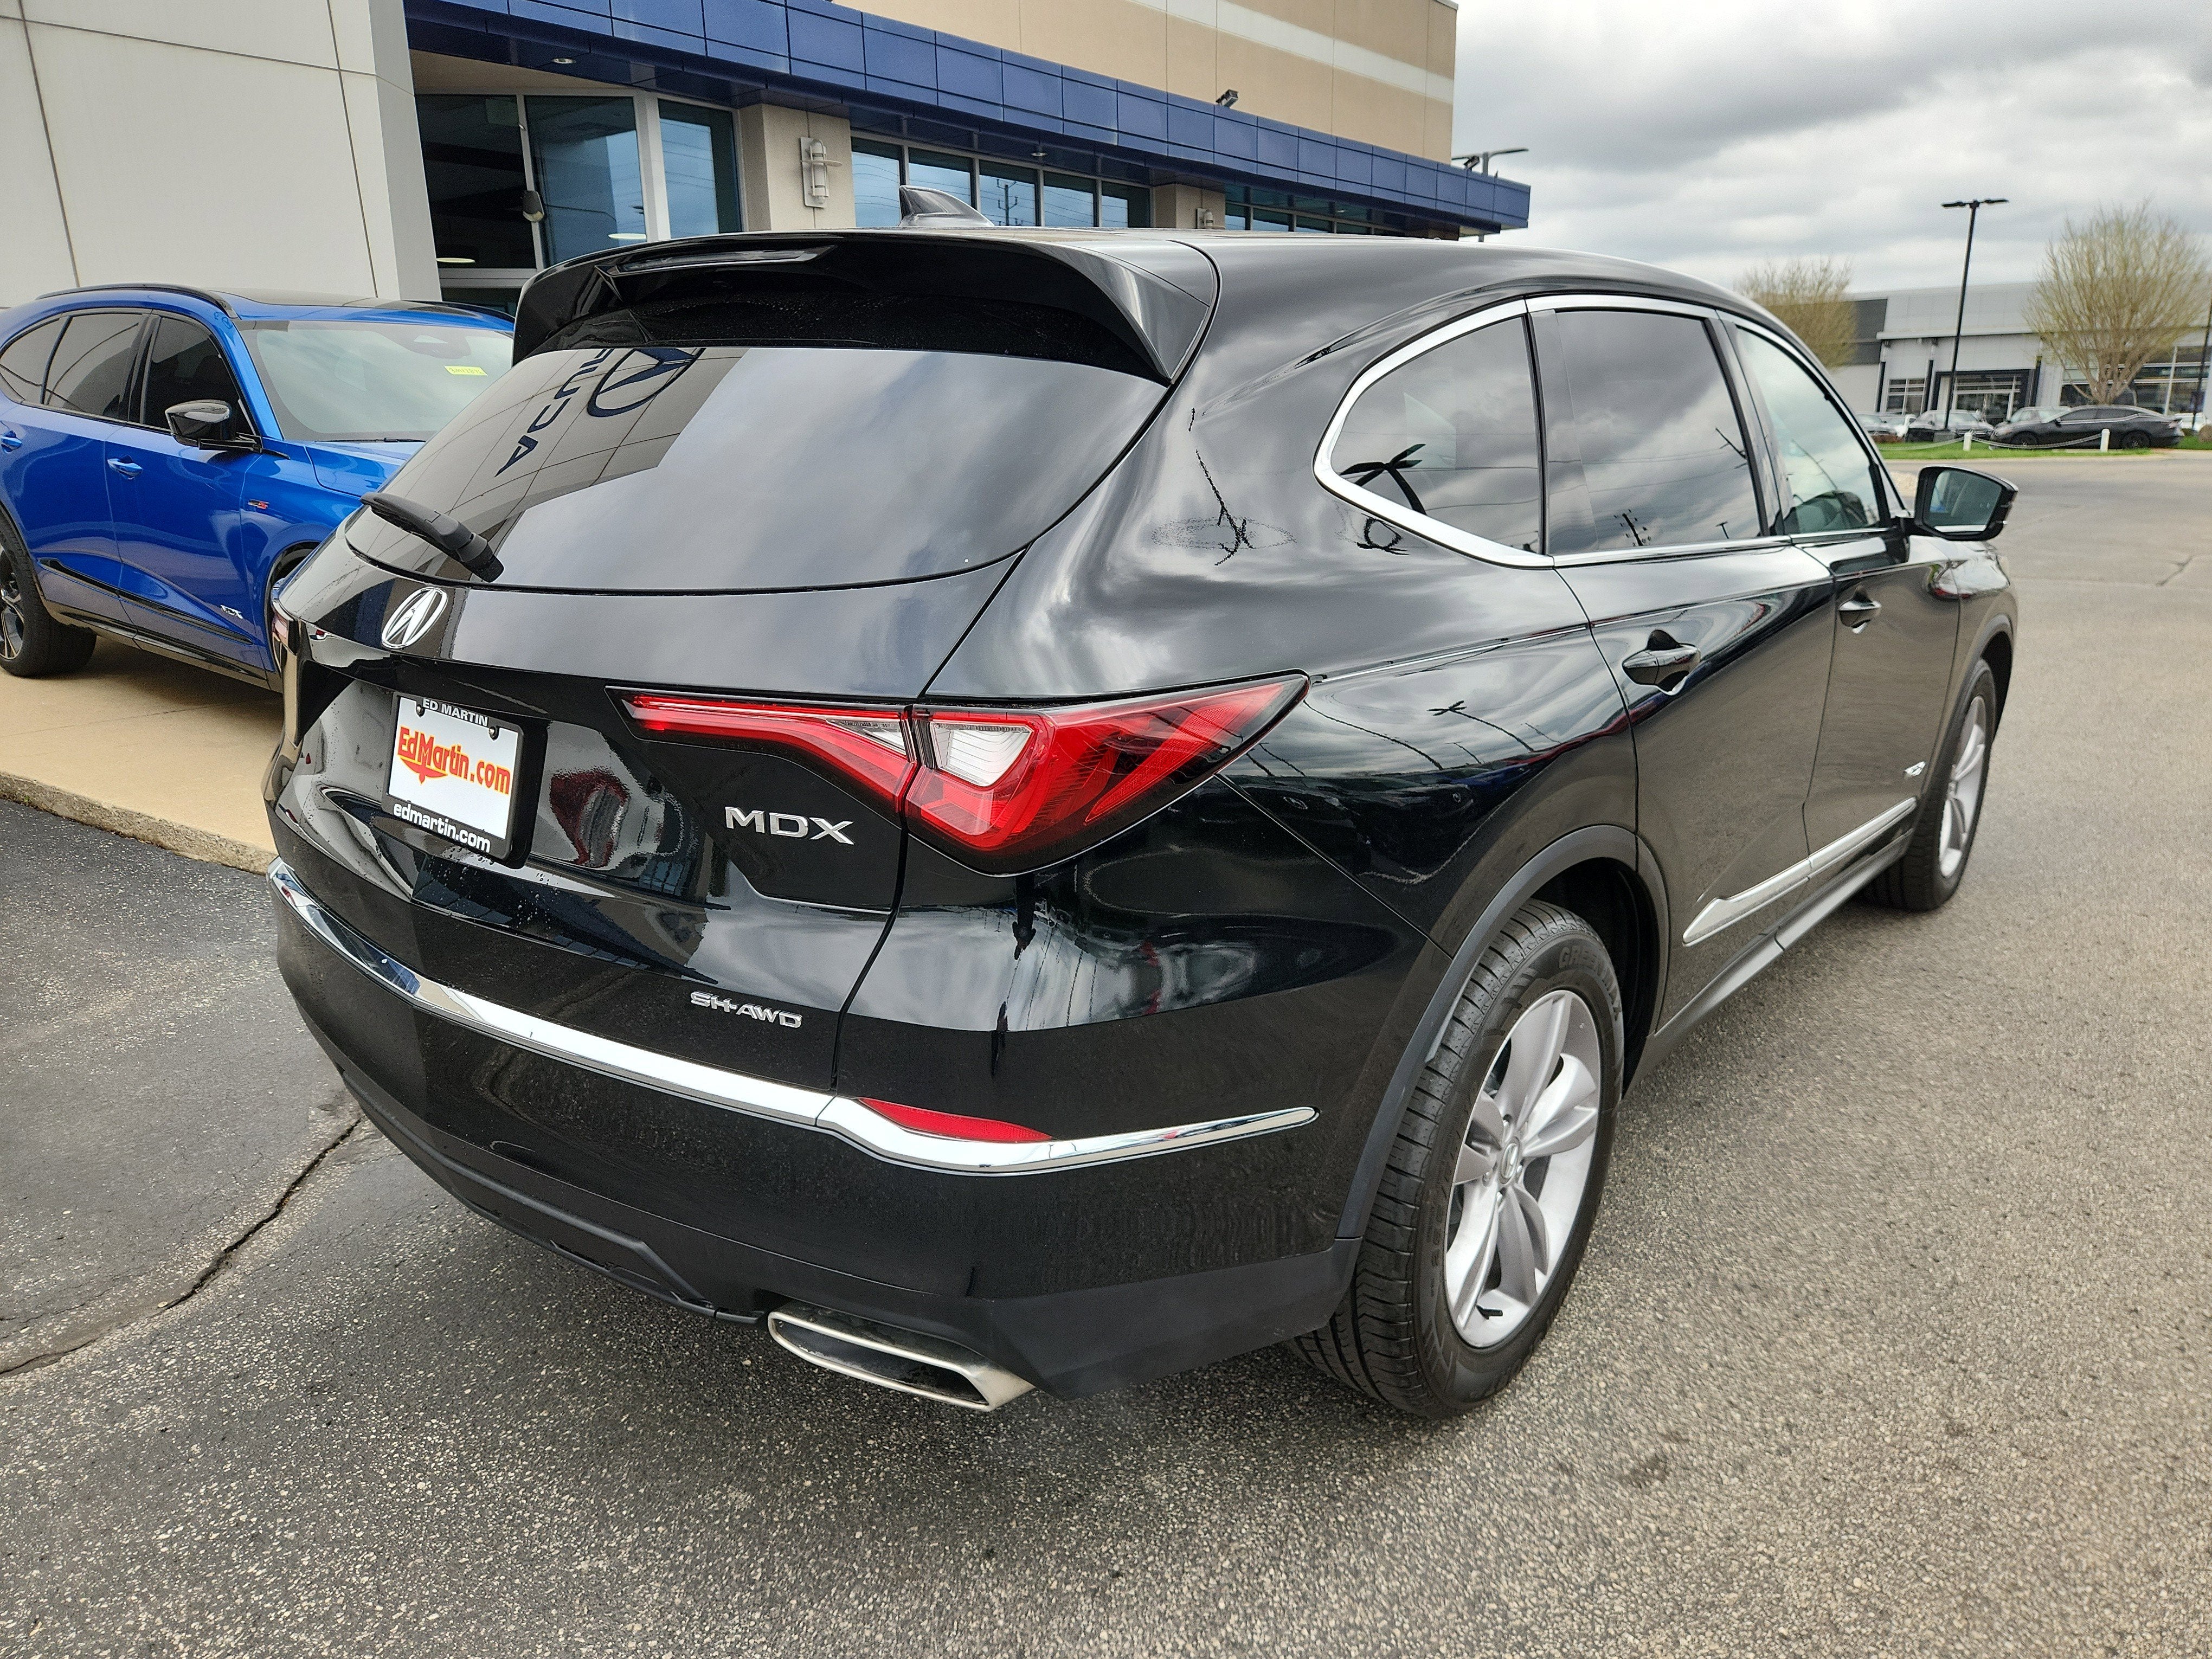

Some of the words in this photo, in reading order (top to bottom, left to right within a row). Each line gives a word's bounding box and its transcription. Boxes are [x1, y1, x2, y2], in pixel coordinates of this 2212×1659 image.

[422, 698, 439, 711] ED
[441, 704, 488, 727] MARTIN
[397, 726, 511, 795] EdMartin.com
[393, 802, 491, 853] edmartin.com
[725, 806, 855, 845] MDX
[690, 991, 803, 1028] SH-AWD
